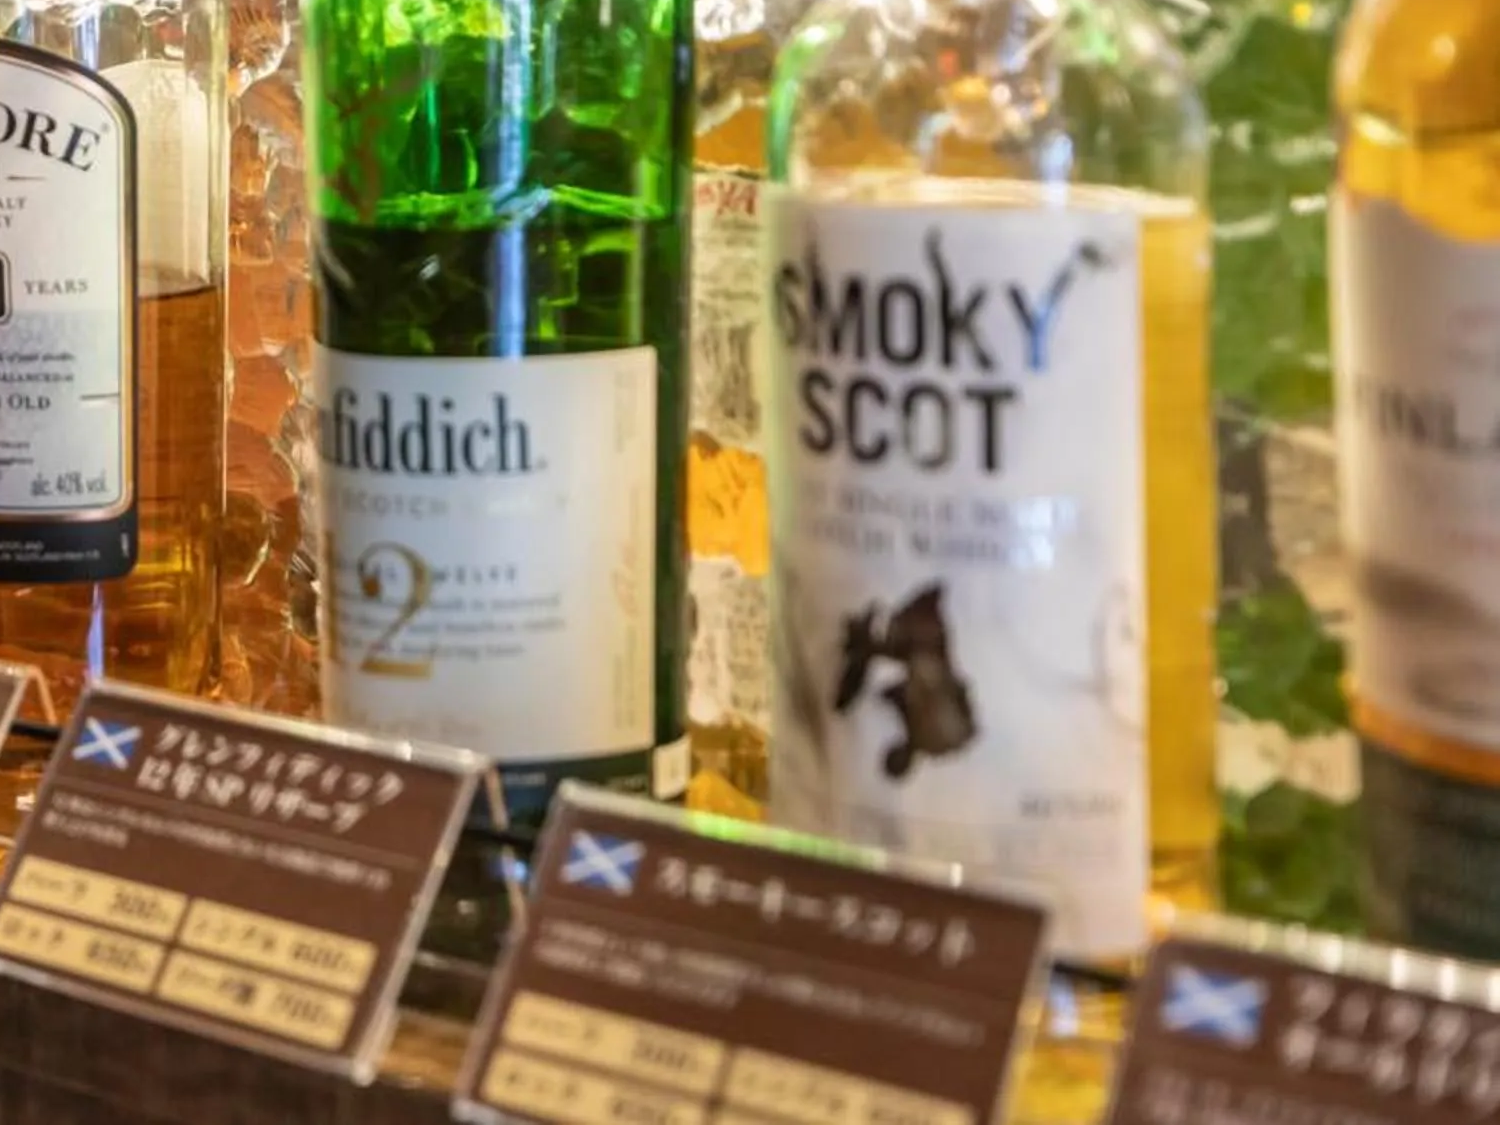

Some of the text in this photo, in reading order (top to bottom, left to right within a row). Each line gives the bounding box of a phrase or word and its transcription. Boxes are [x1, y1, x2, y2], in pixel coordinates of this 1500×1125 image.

[22, 278, 88, 296] YEARS
[774, 249, 1090, 372] SMOKY
[7, 392, 52, 411] OLD
[799, 371, 1019, 473] SCOT
